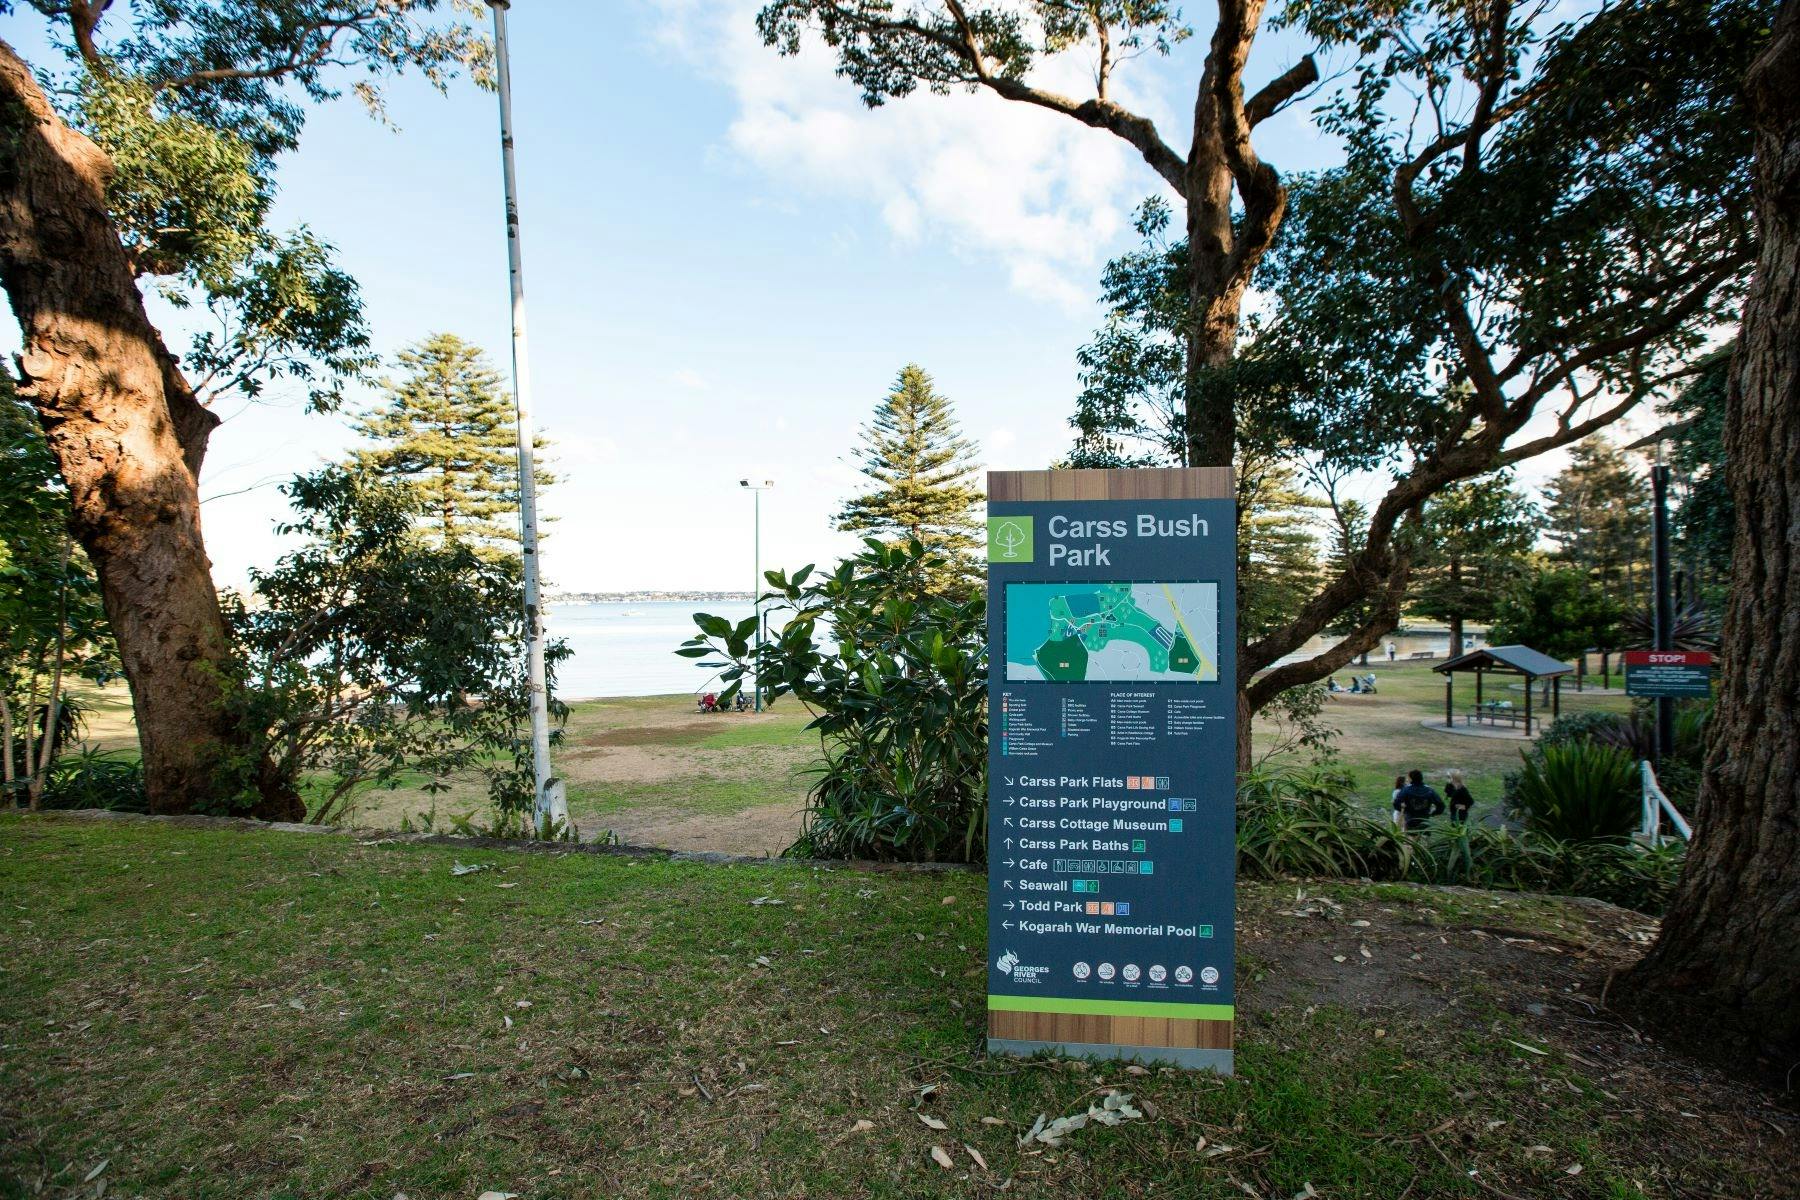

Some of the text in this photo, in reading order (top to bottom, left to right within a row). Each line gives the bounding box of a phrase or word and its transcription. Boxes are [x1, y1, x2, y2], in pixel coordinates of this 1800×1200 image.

[1049, 514, 1209, 538] Carss Bush
[1049, 544, 1111, 566] Park
[1648, 654, 1686, 663] STOP!
[1020, 776, 1124, 788] Carss Park Flats
[1020, 797, 1166, 811] Carss Park Playground
[1020, 818, 1167, 831] Carss Cottage Museum
[1020, 838, 1129, 851] Carss Park Baths
[1020, 859, 1048, 869] Cafe
[1020, 880, 1068, 891] Seawall
[1019, 900, 1083, 912] Todd Park
[1020, 921, 1196, 937] Kogarah War Memorial Pool
